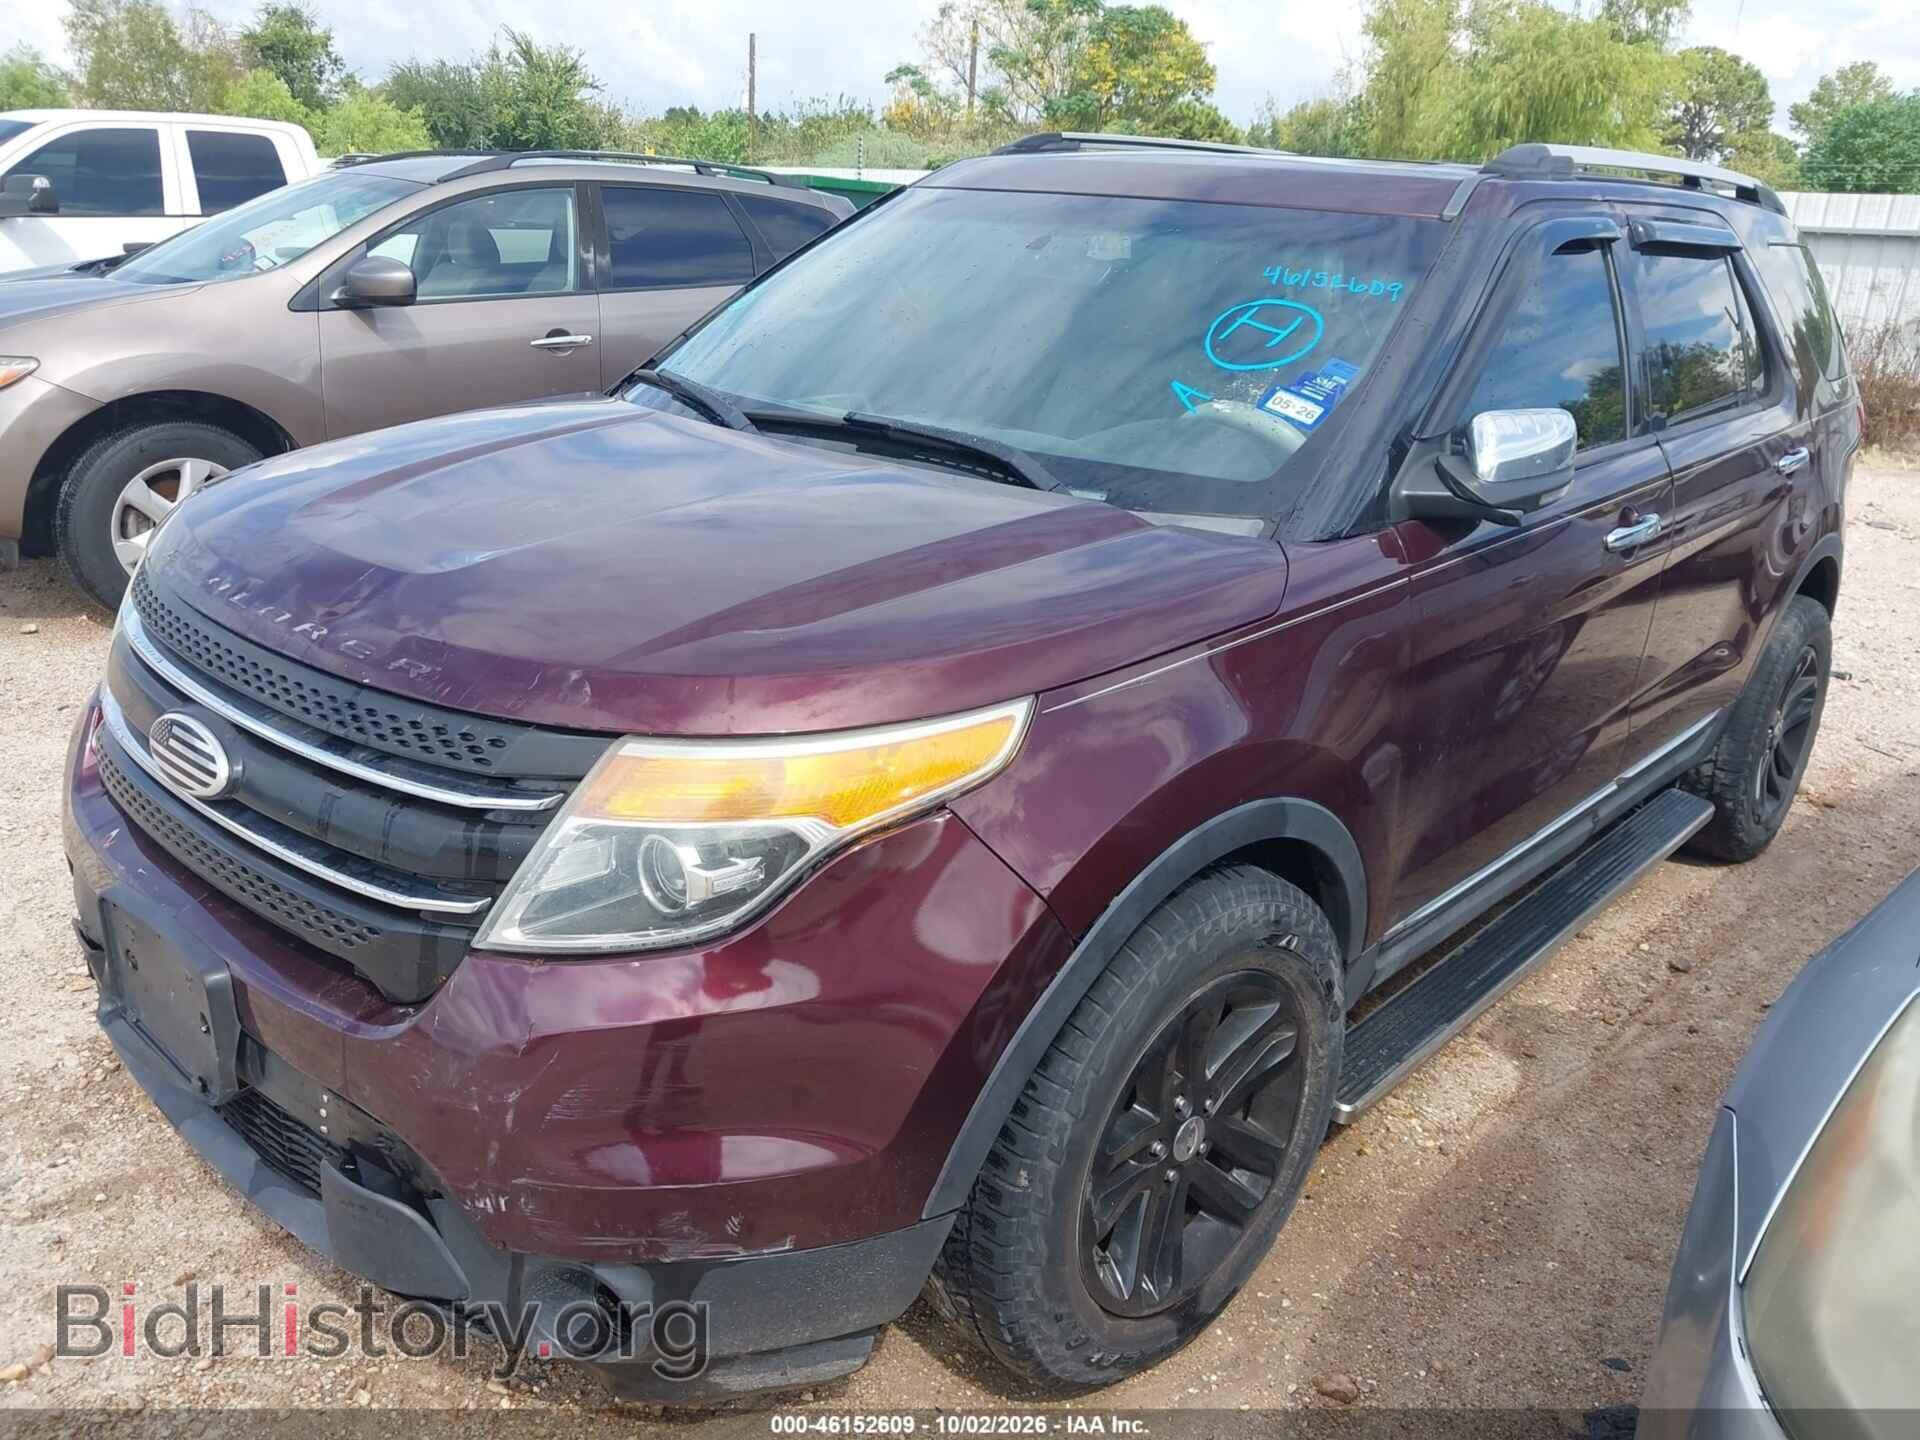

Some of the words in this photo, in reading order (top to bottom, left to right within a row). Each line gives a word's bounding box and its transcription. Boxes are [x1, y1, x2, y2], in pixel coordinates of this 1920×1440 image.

[1217, 306, 1304, 348] H
[1170, 379, 1214, 416] A
[1271, 396, 1293, 410] 05
[1295, 405, 1317, 420] 26
